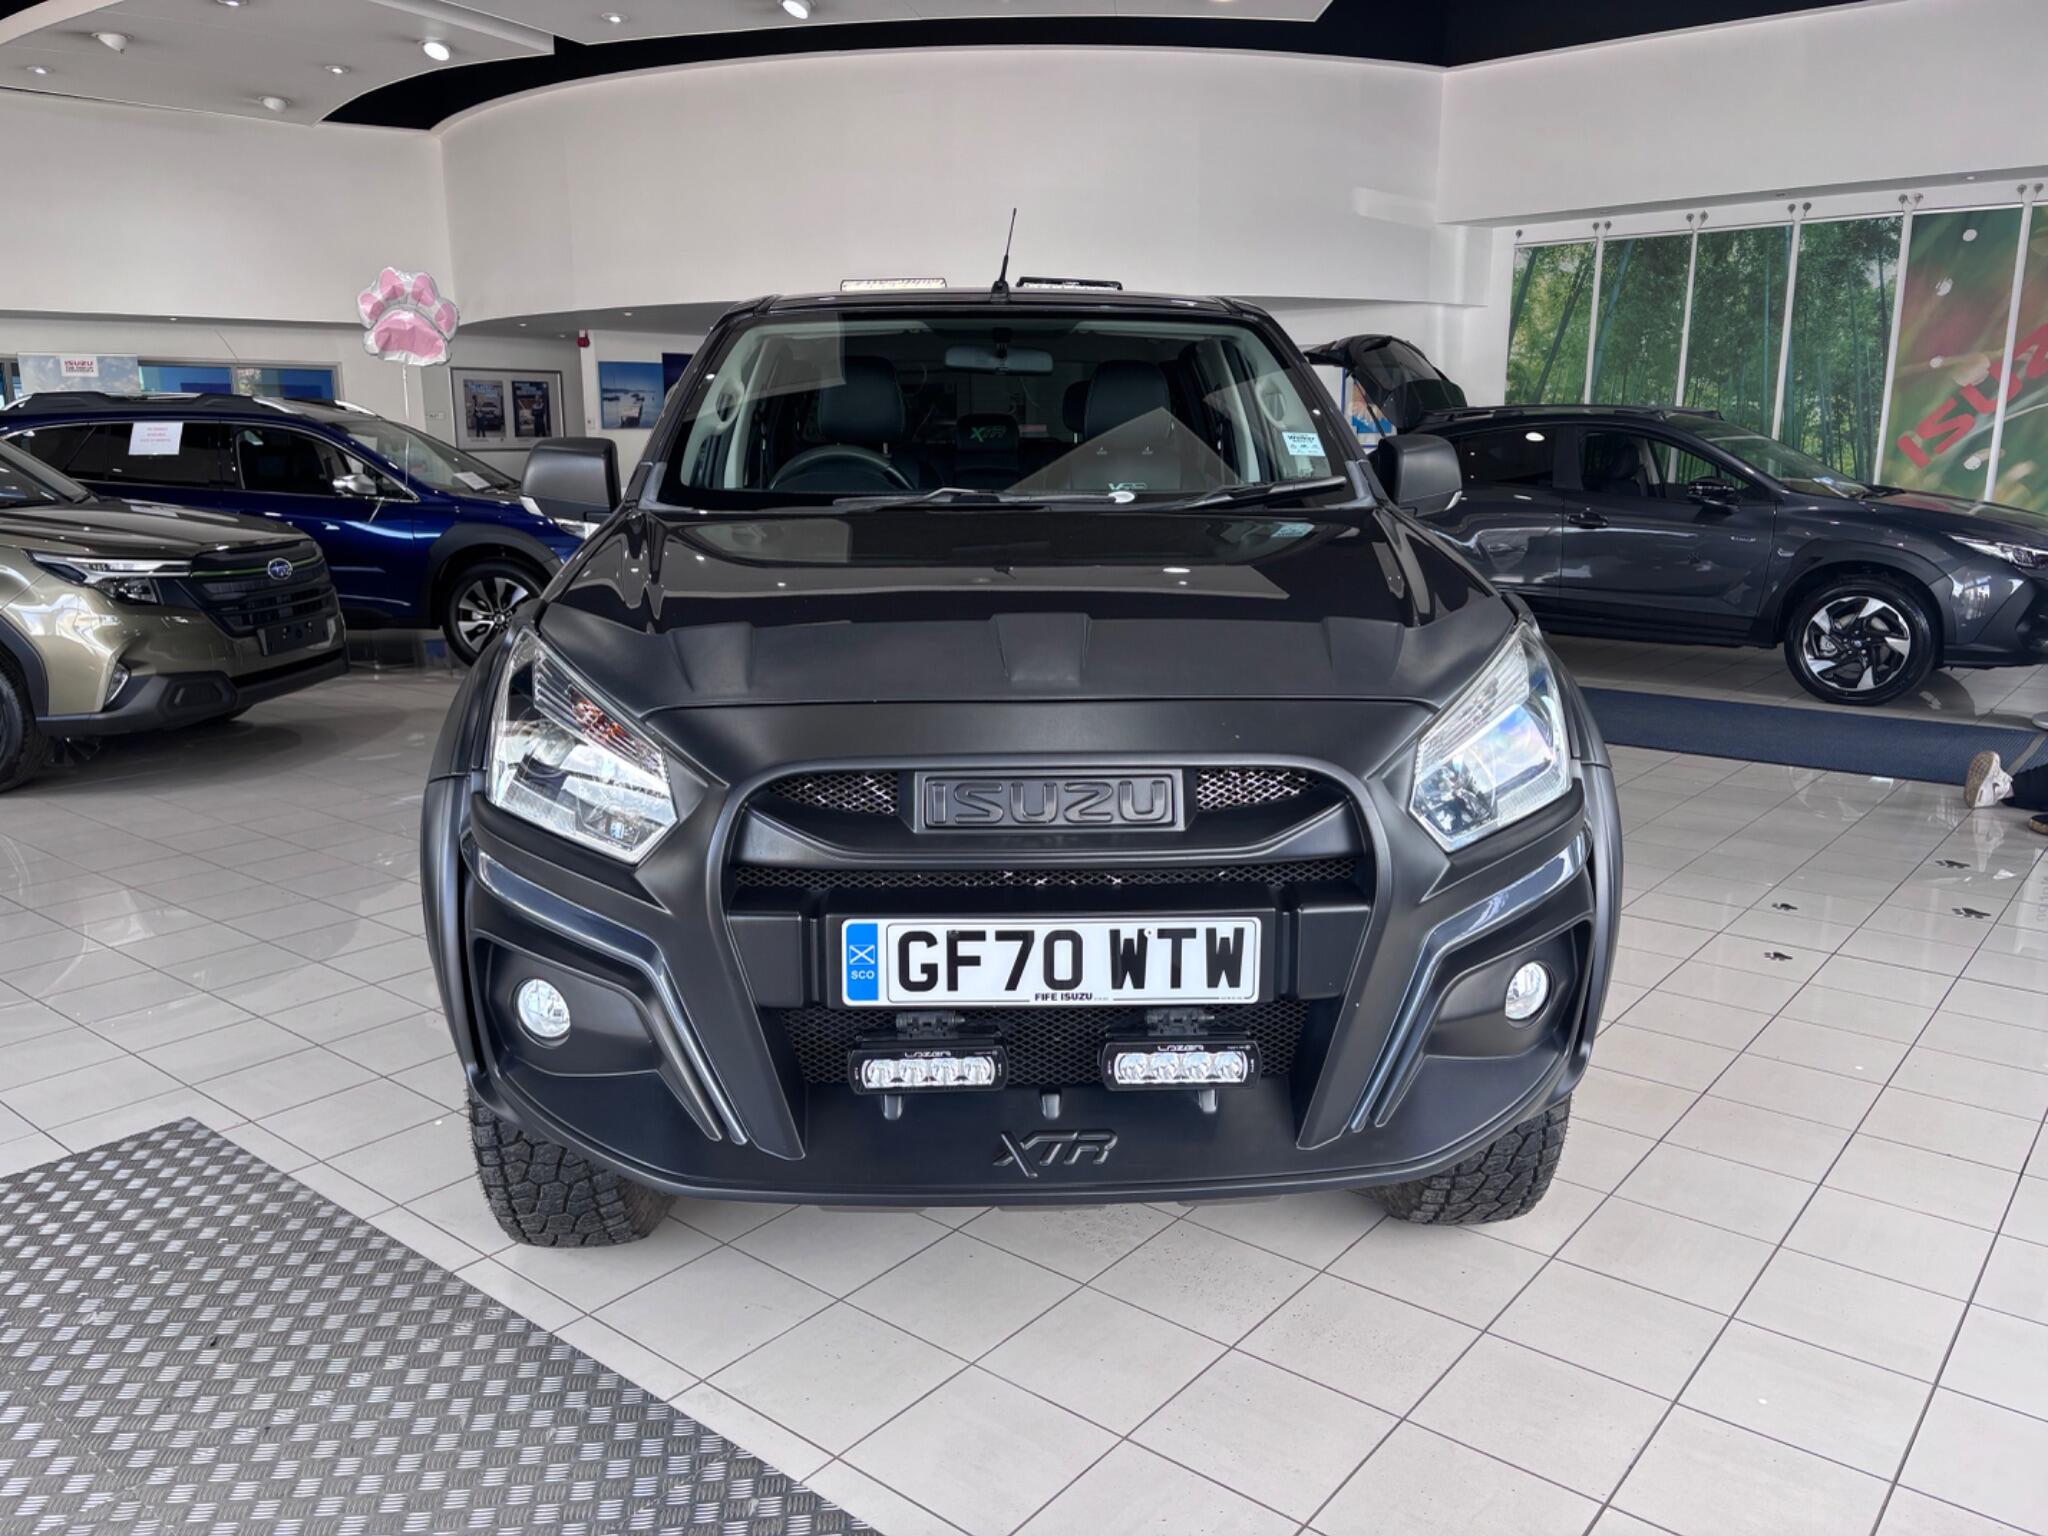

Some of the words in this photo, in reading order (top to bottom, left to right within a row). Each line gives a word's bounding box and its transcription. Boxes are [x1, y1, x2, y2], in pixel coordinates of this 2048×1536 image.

[930, 780, 1168, 824] ISUZU
[850, 969, 876, 980] SCO
[898, 929, 1083, 992] GF70
[1109, 927, 1245, 989] WTW
[1034, 992, 1058, 1001] FIFE
[1061, 991, 1093, 1001] ISUZU
[993, 1130, 1118, 1178] XTR
